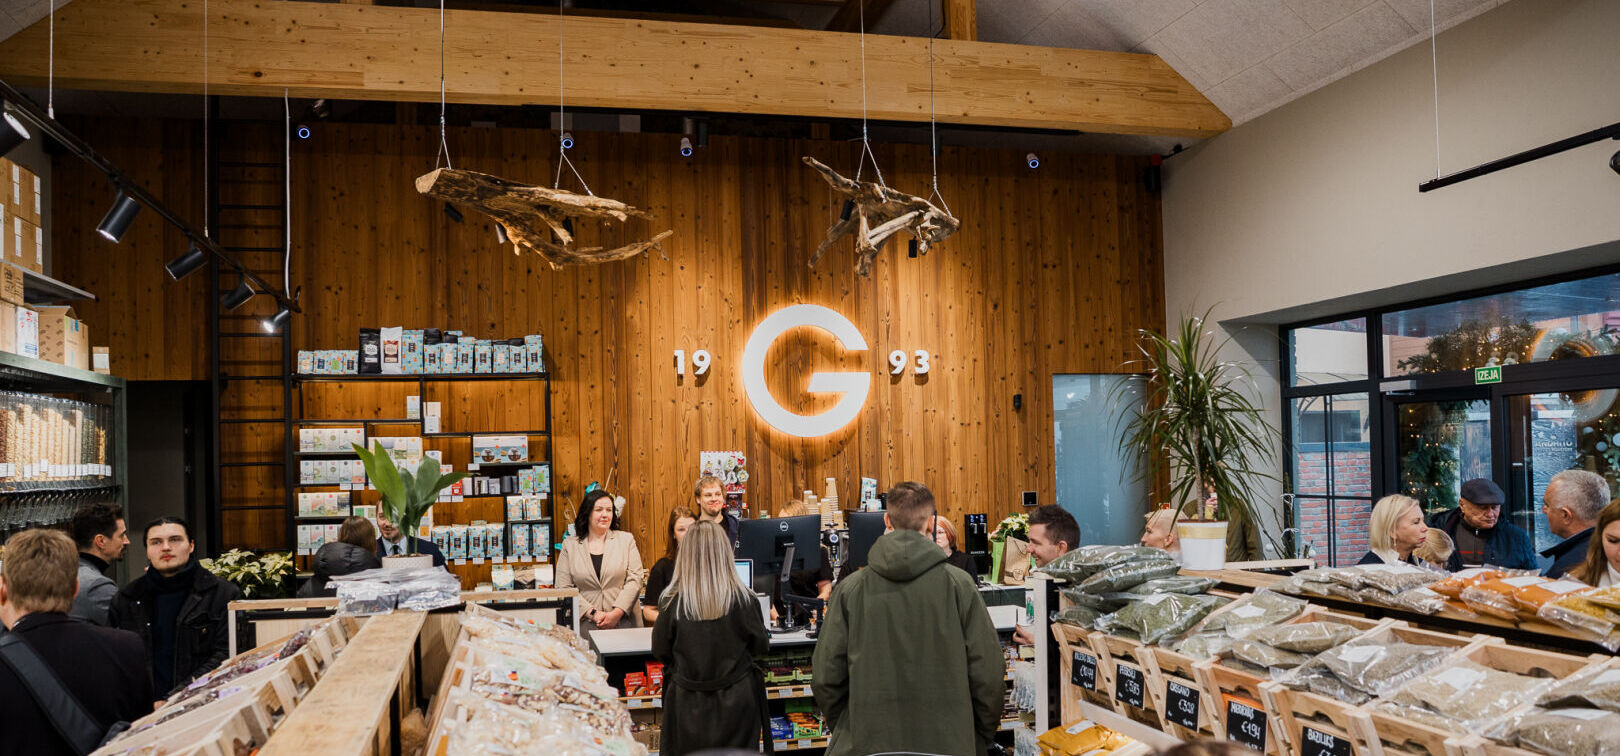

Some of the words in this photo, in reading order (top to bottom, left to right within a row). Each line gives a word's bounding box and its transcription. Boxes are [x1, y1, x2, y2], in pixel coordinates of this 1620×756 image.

[673, 349, 711, 375] 19
[741, 304, 871, 438] G
[889, 349, 931, 375] 93
[1477, 369, 1499, 381] IZEJA
